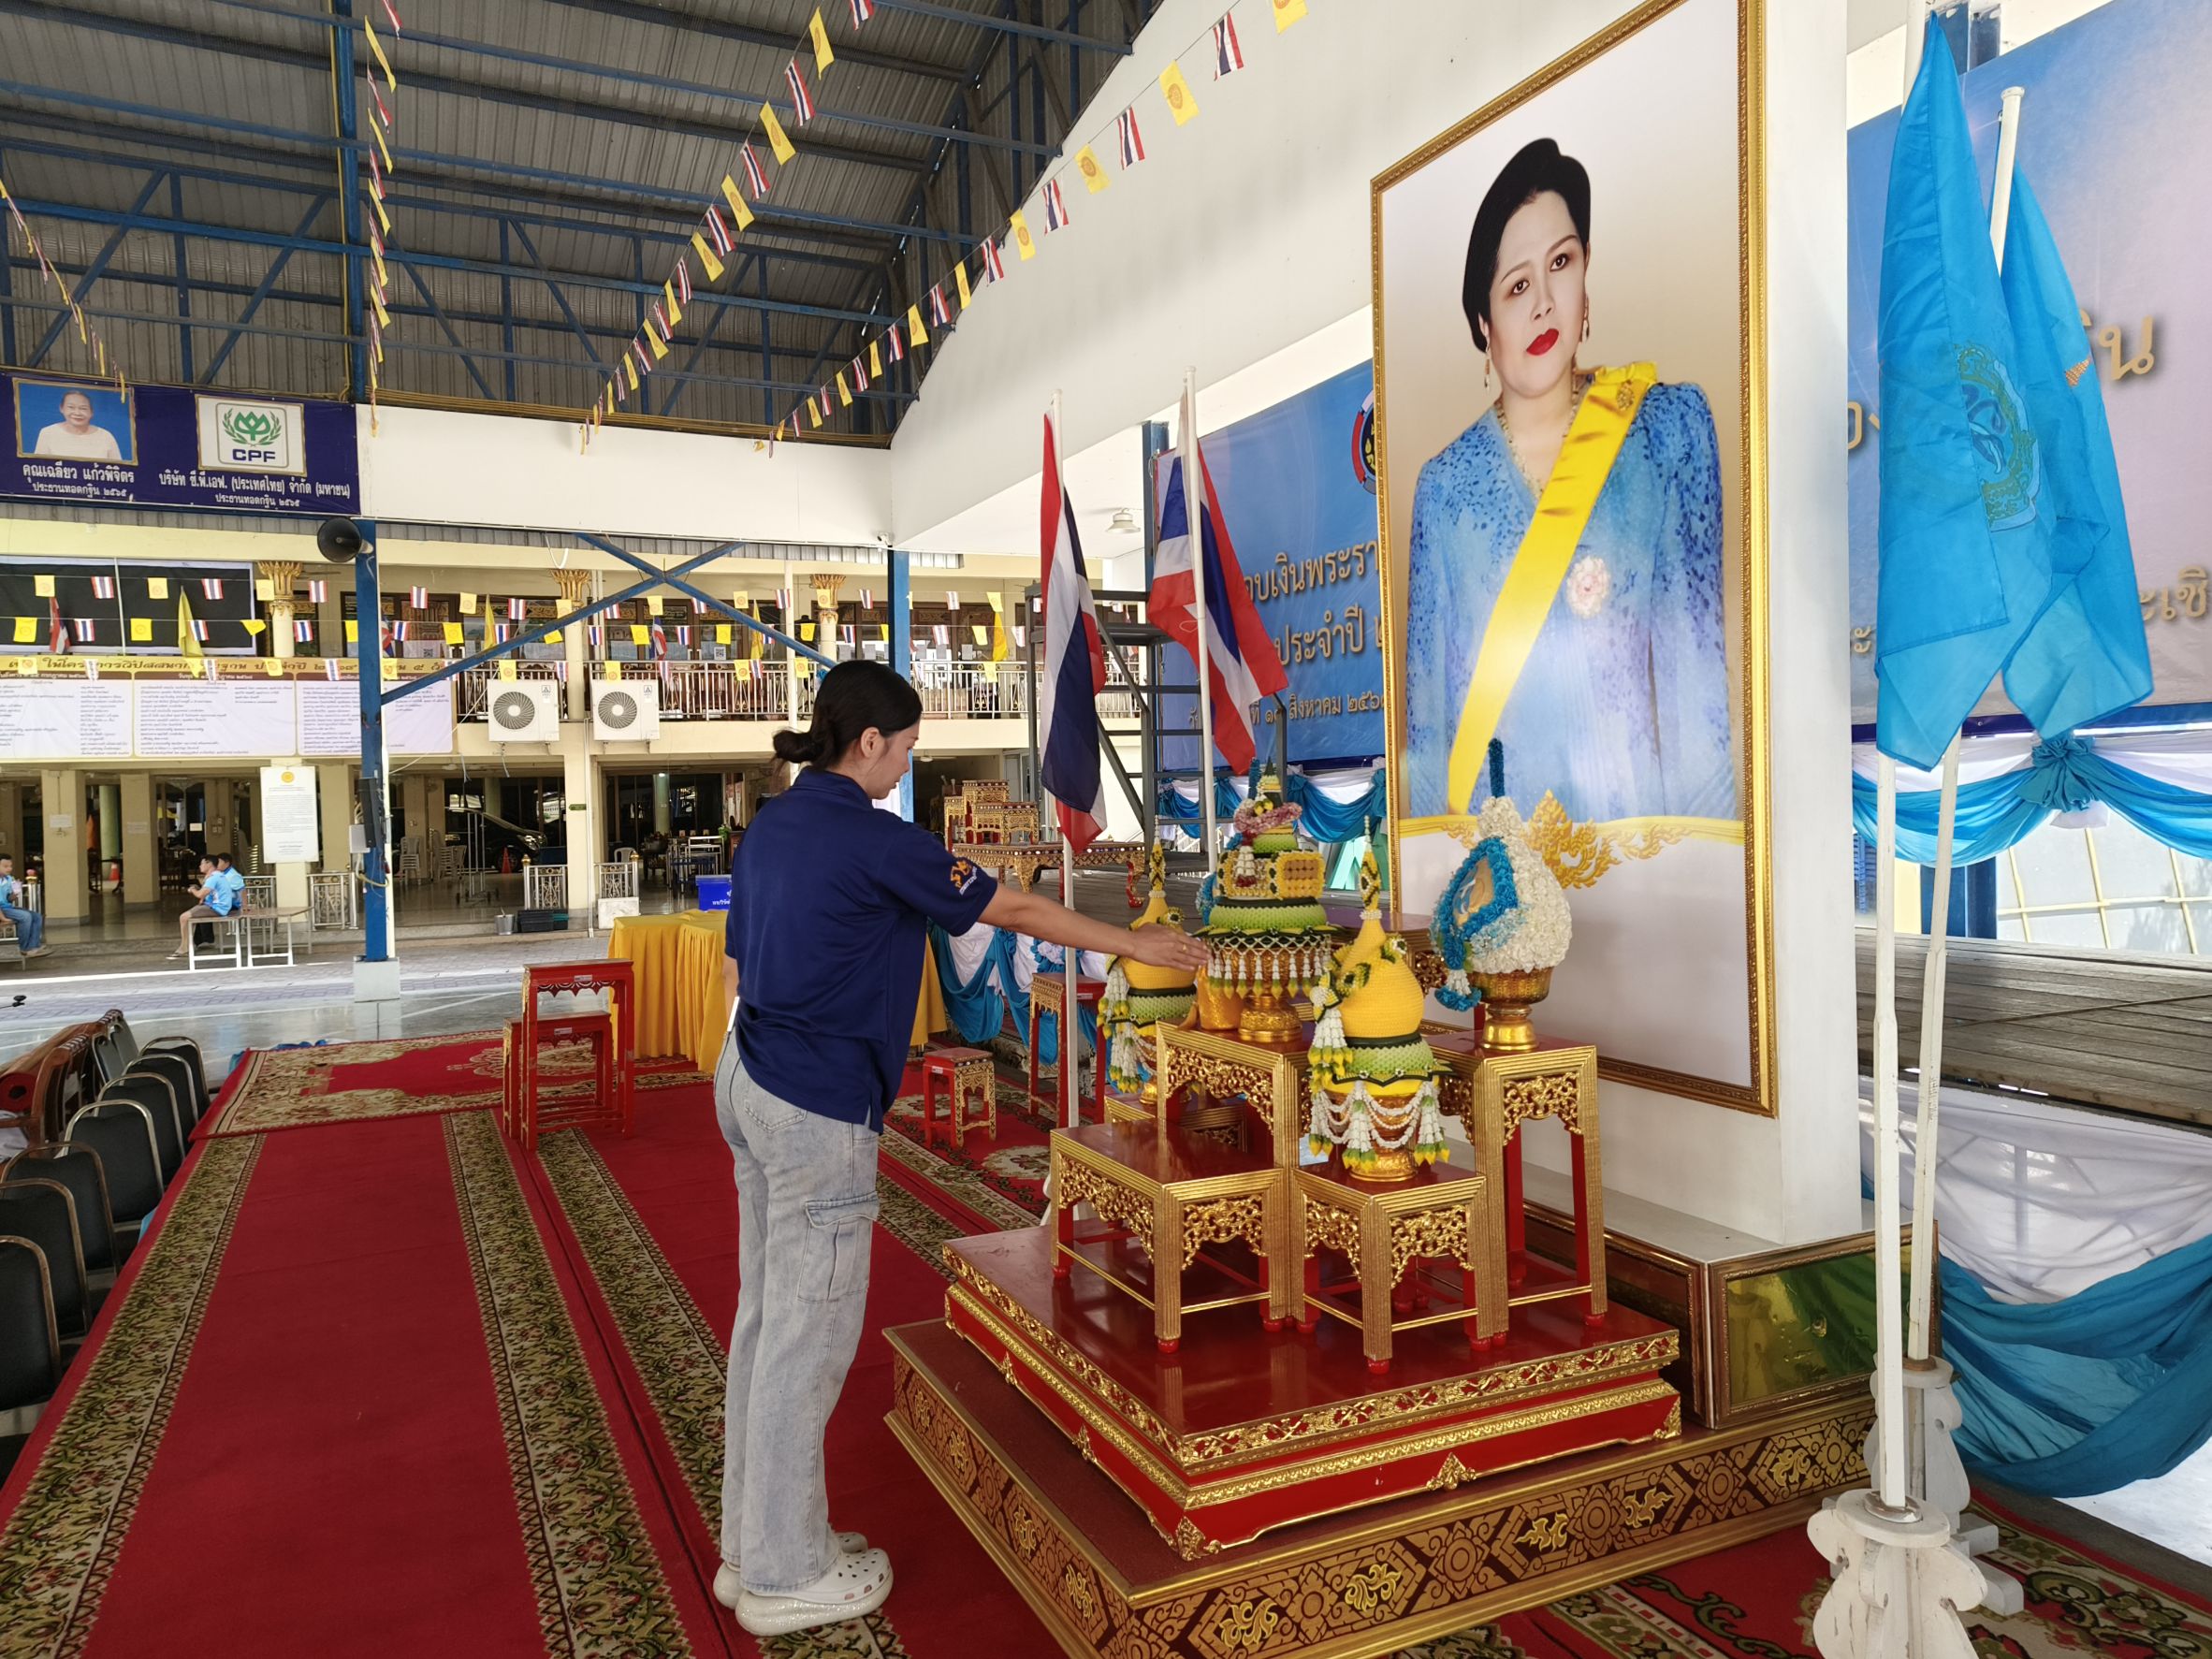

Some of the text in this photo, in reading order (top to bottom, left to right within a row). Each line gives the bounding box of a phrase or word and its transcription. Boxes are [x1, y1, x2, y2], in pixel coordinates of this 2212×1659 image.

[232, 448, 276, 462] CPF
[22, 460, 78, 484] คุณเฉลียว
[158, 469, 186, 487] บริษัท
[231, 474, 285, 495] (ประเทศไทย)
[288, 476, 312, 495] จำกัด
[315, 482, 351, 499] (มหาชน)
[1274, 604, 1364, 665] ประจำปี
[1288, 693, 1342, 720] สิงหาคม
[1347, 691, 1385, 713] ๒๕๖
